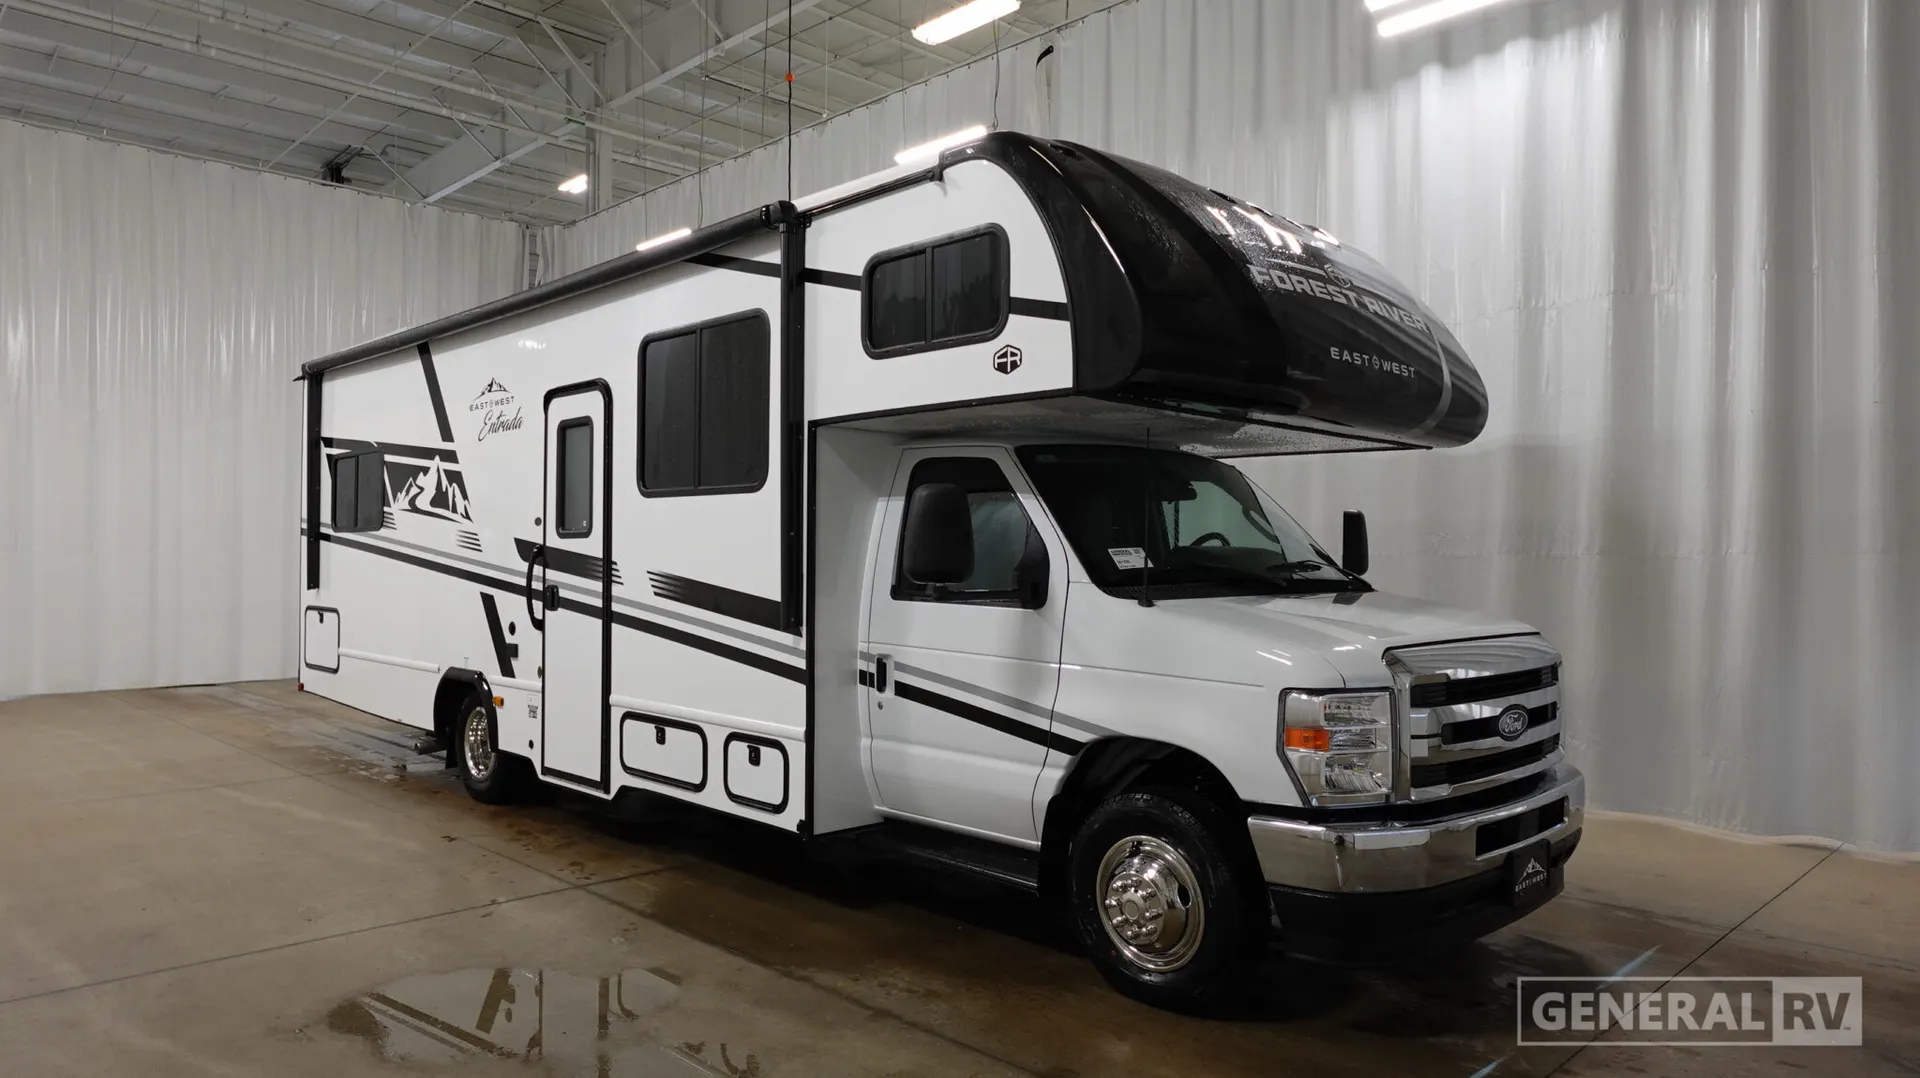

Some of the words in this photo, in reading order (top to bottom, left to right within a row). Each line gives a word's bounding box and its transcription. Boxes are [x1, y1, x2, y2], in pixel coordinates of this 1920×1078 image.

[1246, 264, 1360, 308] FOREST
[1364, 297, 1430, 333] RIVER
[1330, 347, 1369, 367] EAST
[1381, 359, 1415, 378] WEST
[478, 406, 523, 441] Entrada
[1504, 713, 1523, 733] Ford
